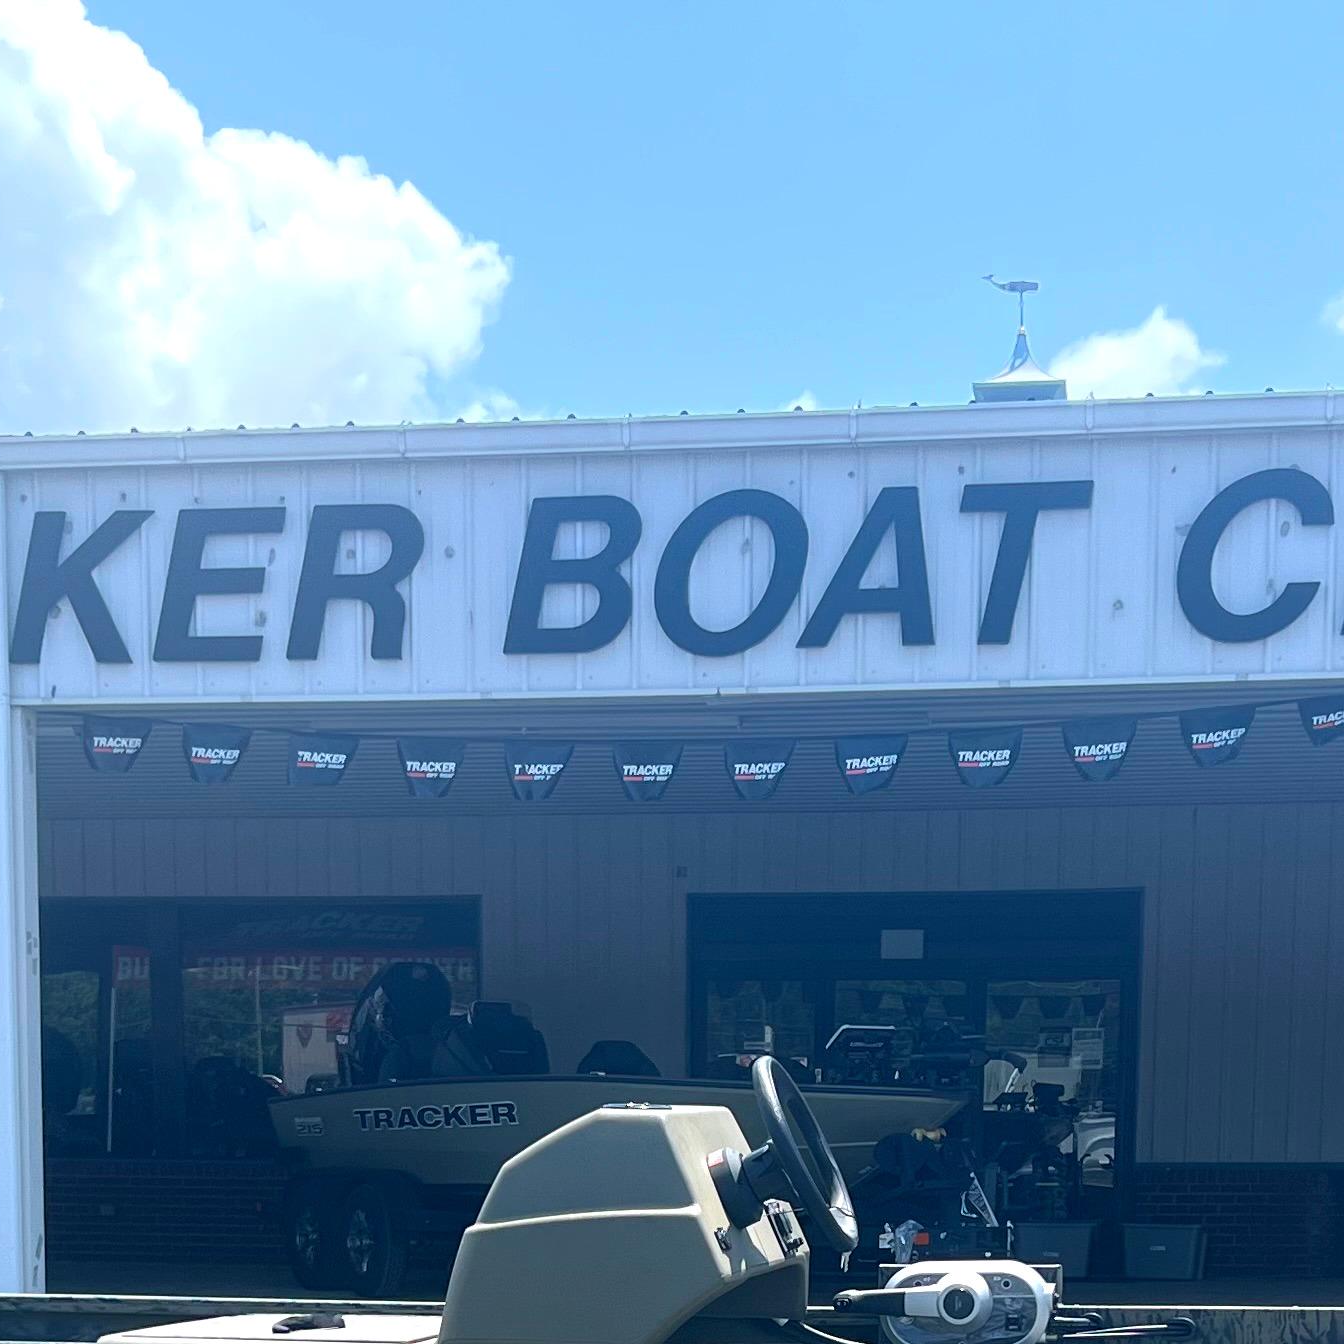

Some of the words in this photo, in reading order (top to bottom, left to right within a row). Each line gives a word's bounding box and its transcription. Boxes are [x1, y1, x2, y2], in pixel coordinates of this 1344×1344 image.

[503, 480, 1095, 658] BOAT
[191, 747, 240, 759] TRACKER
[958, 750, 1011, 762] TRACKER
[1074, 742, 1127, 757] TRACKER
[297, 751, 347, 764] TRACKER
[845, 754, 897, 770] TRACKER
[406, 761, 456, 773] TRACKER
[623, 764, 674, 776] TRACKER
[354, 1101, 520, 1131] TRACKER
